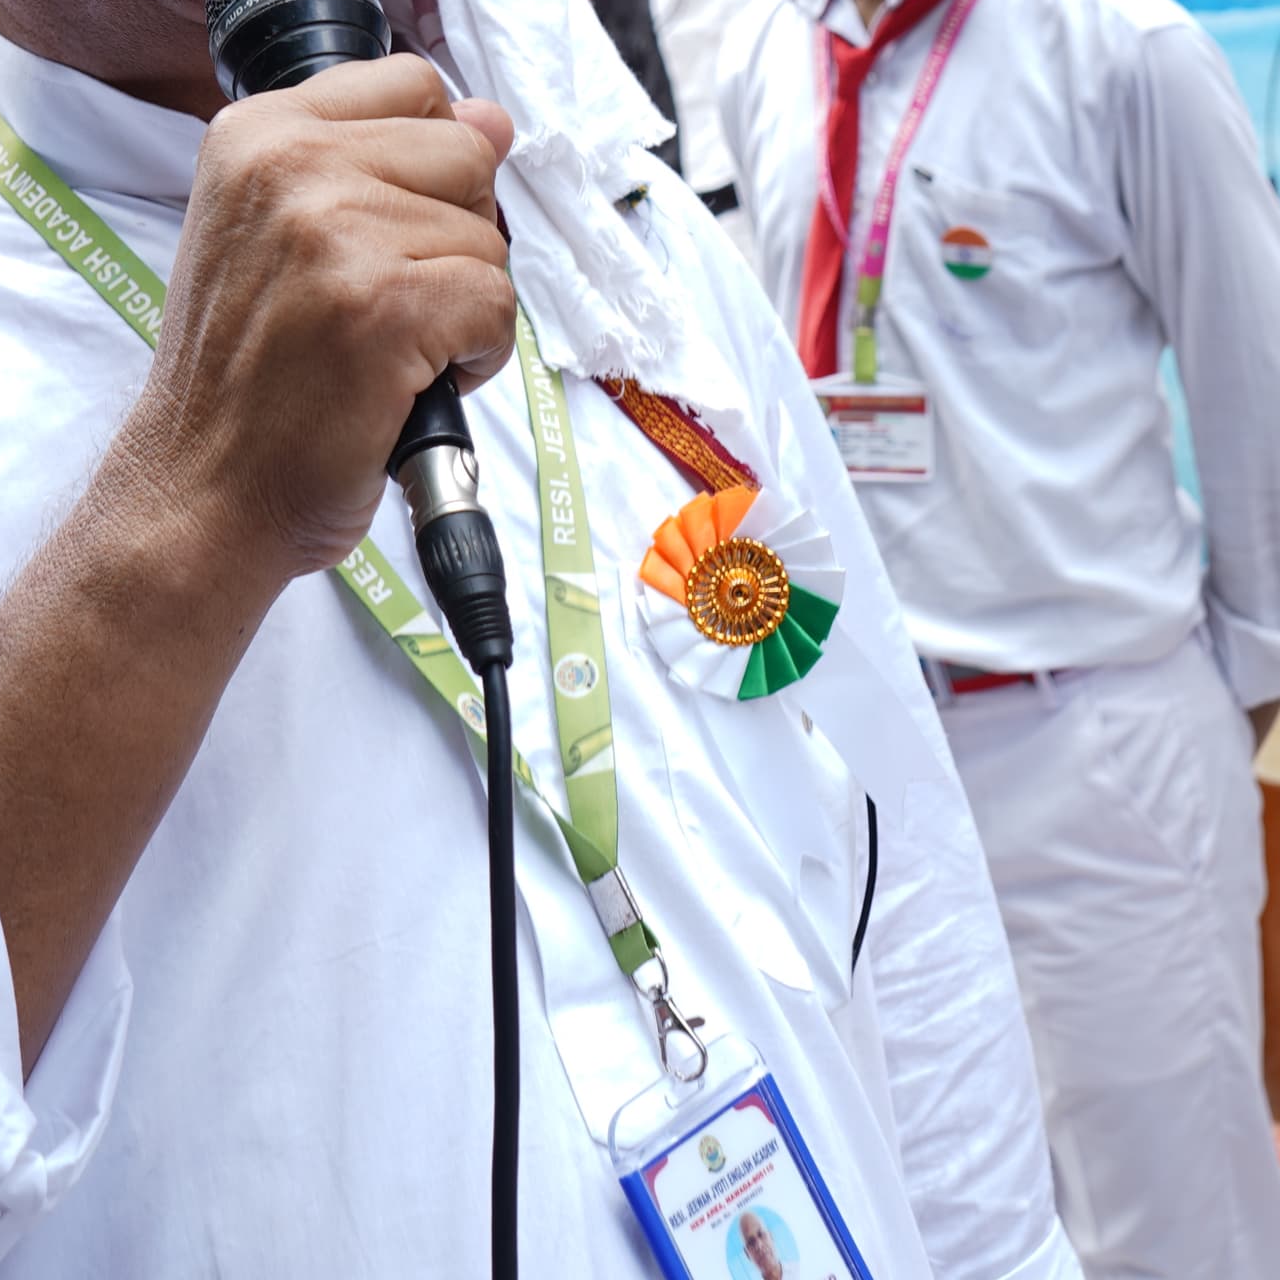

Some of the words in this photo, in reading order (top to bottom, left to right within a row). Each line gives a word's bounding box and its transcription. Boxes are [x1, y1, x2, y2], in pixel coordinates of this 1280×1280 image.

[81, 244, 165, 337] NGLISH
[529, 355, 566, 463] JEEVAN
[550, 472, 576, 544] RESI.
[340, 546, 395, 607] RES
